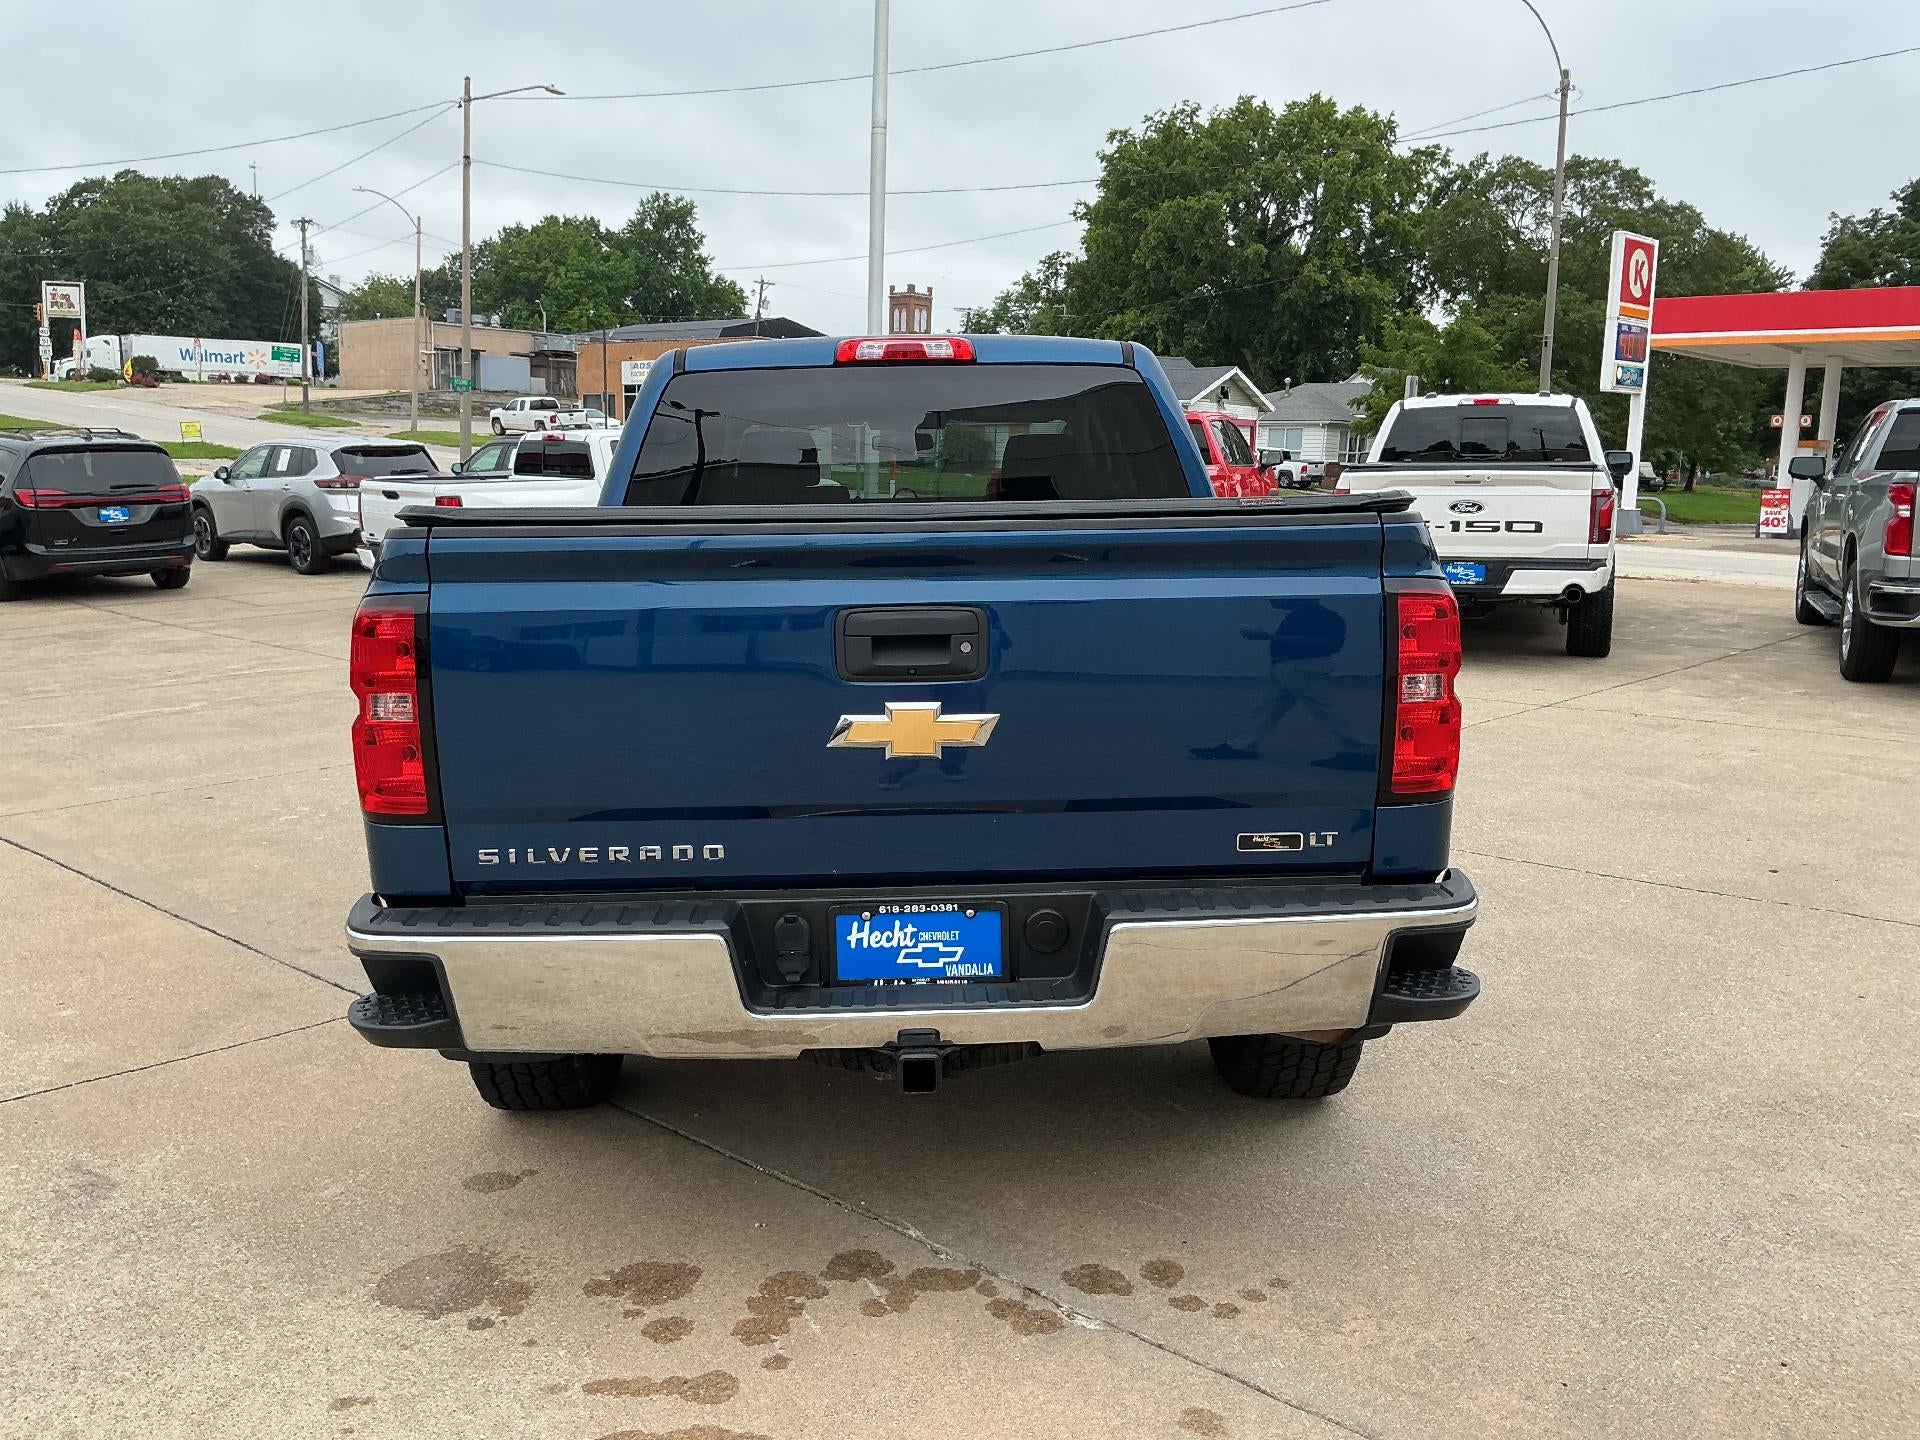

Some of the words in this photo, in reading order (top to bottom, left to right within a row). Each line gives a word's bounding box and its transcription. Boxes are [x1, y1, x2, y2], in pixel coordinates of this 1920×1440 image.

[1455, 502, 1479, 513] Ford
[1424, 520, 1544, 534] -150
[1309, 831, 1339, 848] LT
[478, 844, 726, 866] SILVERADO
[878, 903, 959, 914] 618-283-0381
[846, 919, 918, 949] Hecht
[918, 930, 960, 941] CHEVROLET
[945, 963, 994, 977] VANDALIA
